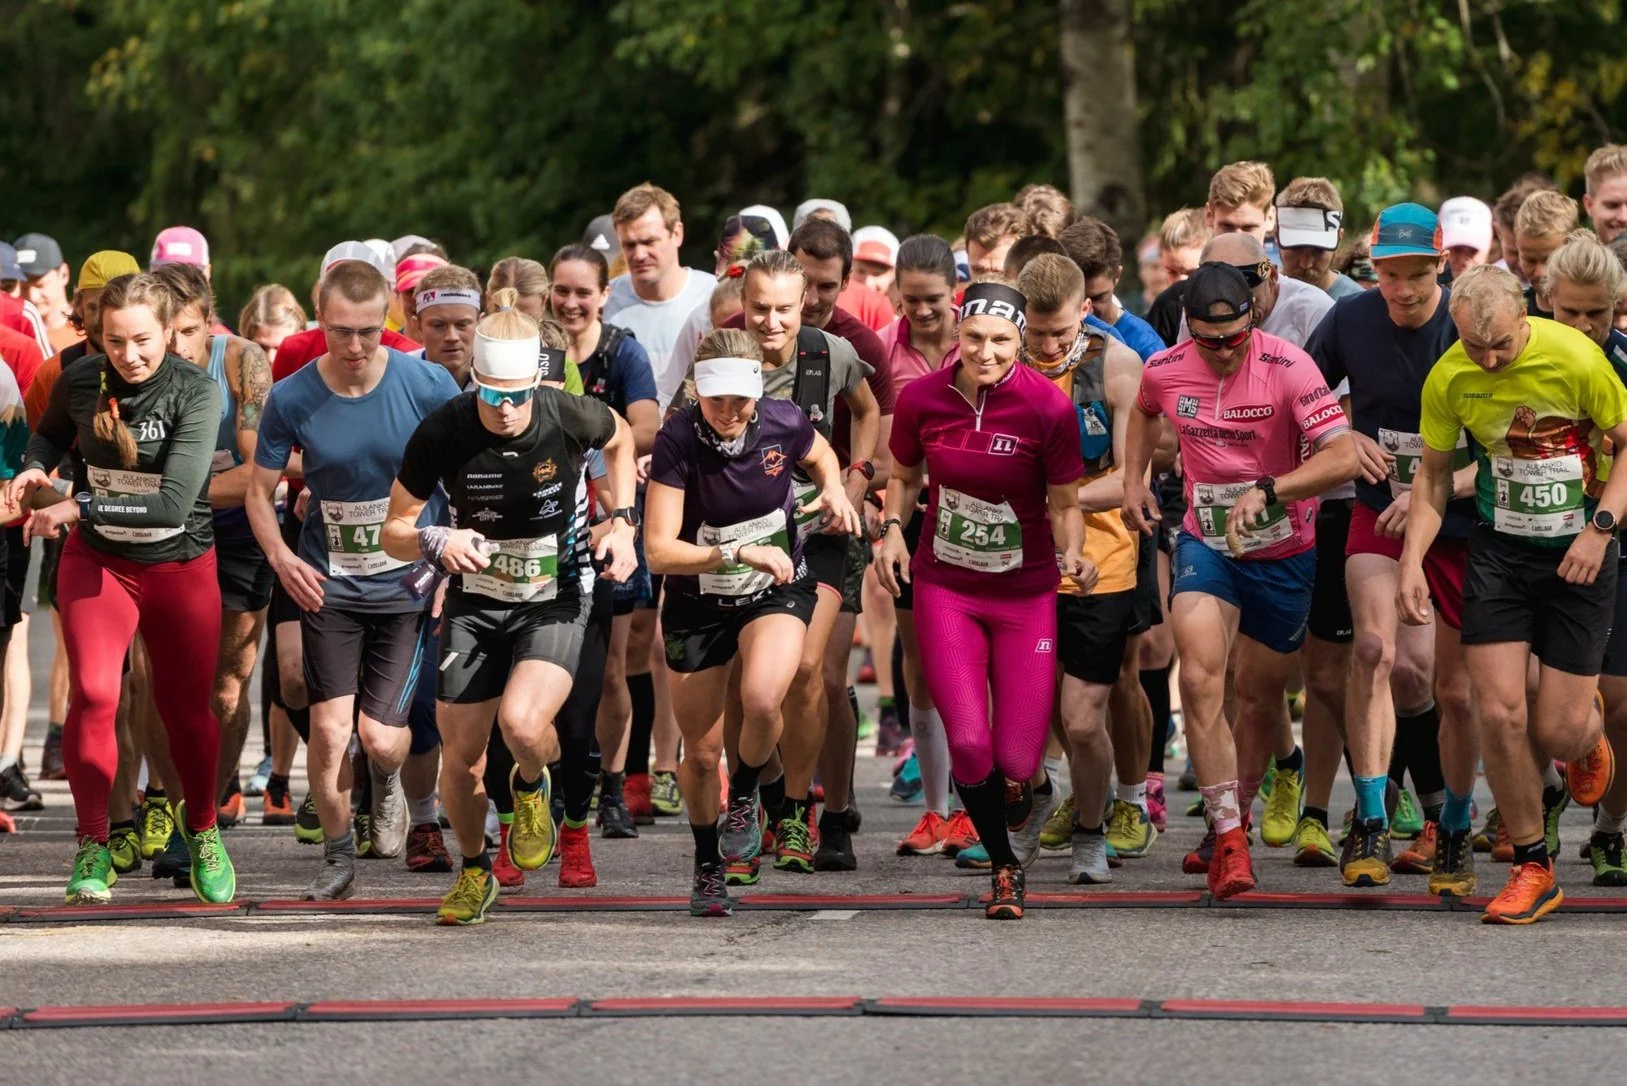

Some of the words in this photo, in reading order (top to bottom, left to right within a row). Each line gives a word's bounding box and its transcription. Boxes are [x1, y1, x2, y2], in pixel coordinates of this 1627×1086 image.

[1147, 351, 1185, 369] Santini
[1259, 352, 1295, 368] Santini
[1223, 406, 1272, 420] BALOCCO
[139, 420, 166, 440] 361
[1235, 430, 1257, 442] Sport
[1518, 467, 1547, 477] TOWER
[1549, 466, 1571, 475] TRAIL
[1525, 461, 1563, 470] AULANKO
[1520, 483, 1567, 507] 450
[104, 504, 126, 513] DEGREE
[126, 506, 148, 514] BEYOND
[349, 508, 376, 518] TOWER
[960, 520, 1006, 546] 254
[493, 555, 541, 578] 486
